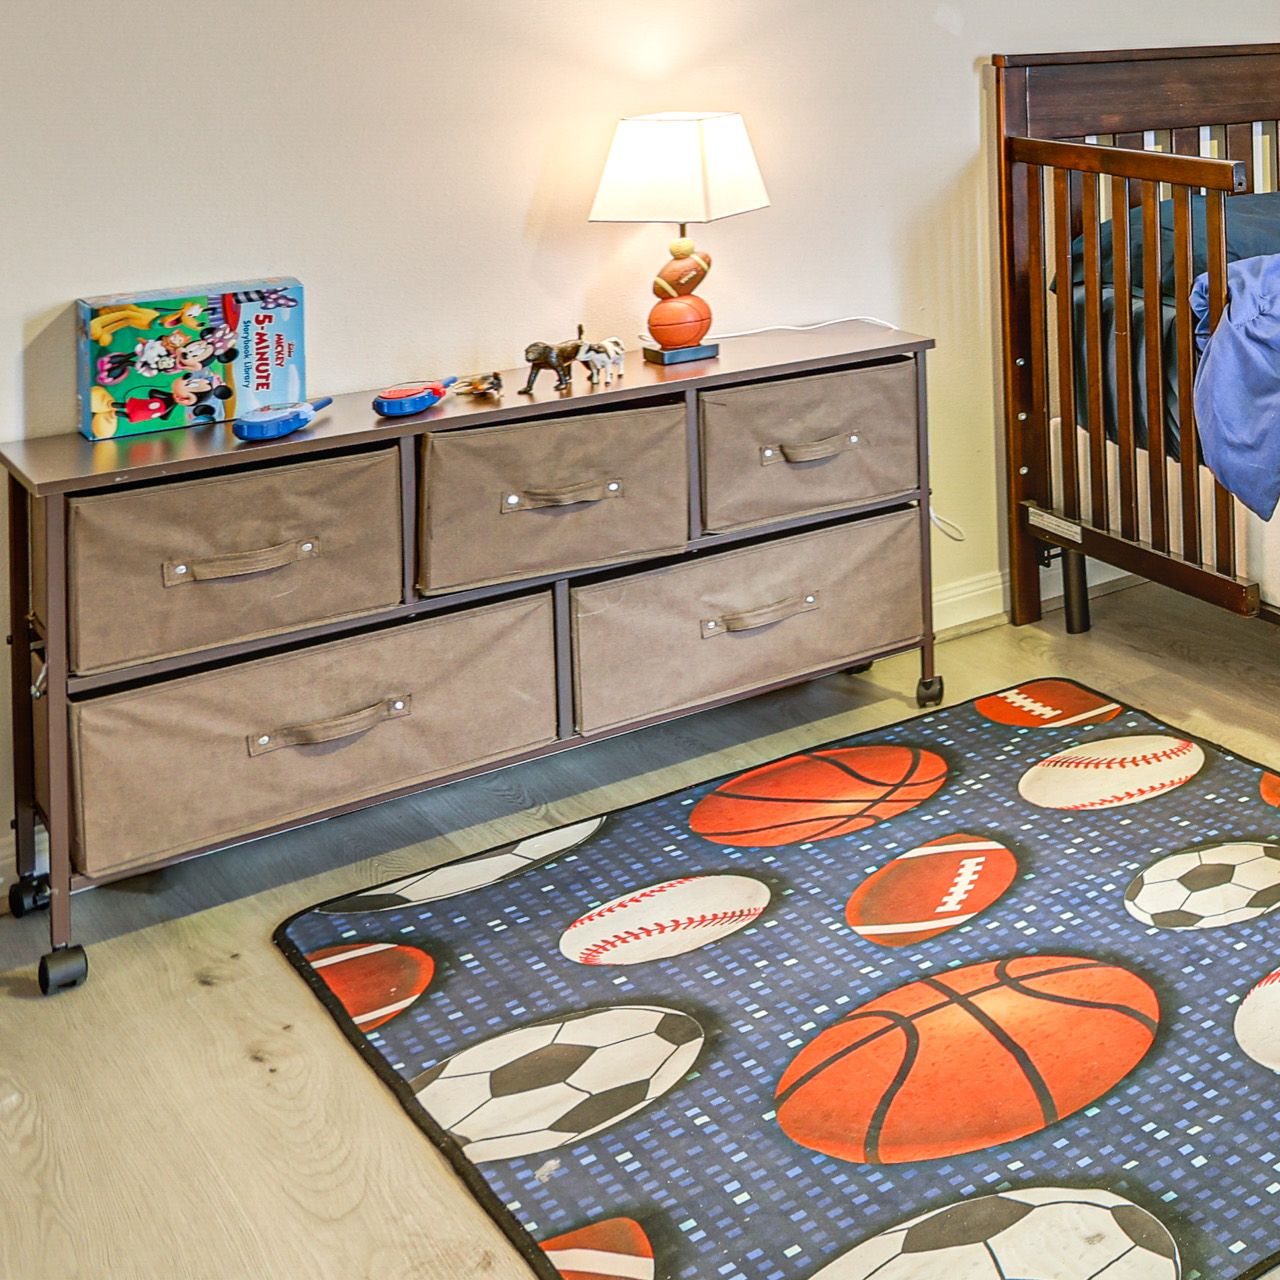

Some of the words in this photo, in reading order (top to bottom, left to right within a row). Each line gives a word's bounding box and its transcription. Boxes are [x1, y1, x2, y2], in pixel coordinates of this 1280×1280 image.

[242, 320, 252, 360] Storybook
[254, 314, 273, 391] 5-MINUTE
[275, 333, 285, 368] MICKEY
[242, 361, 253, 388] Library
